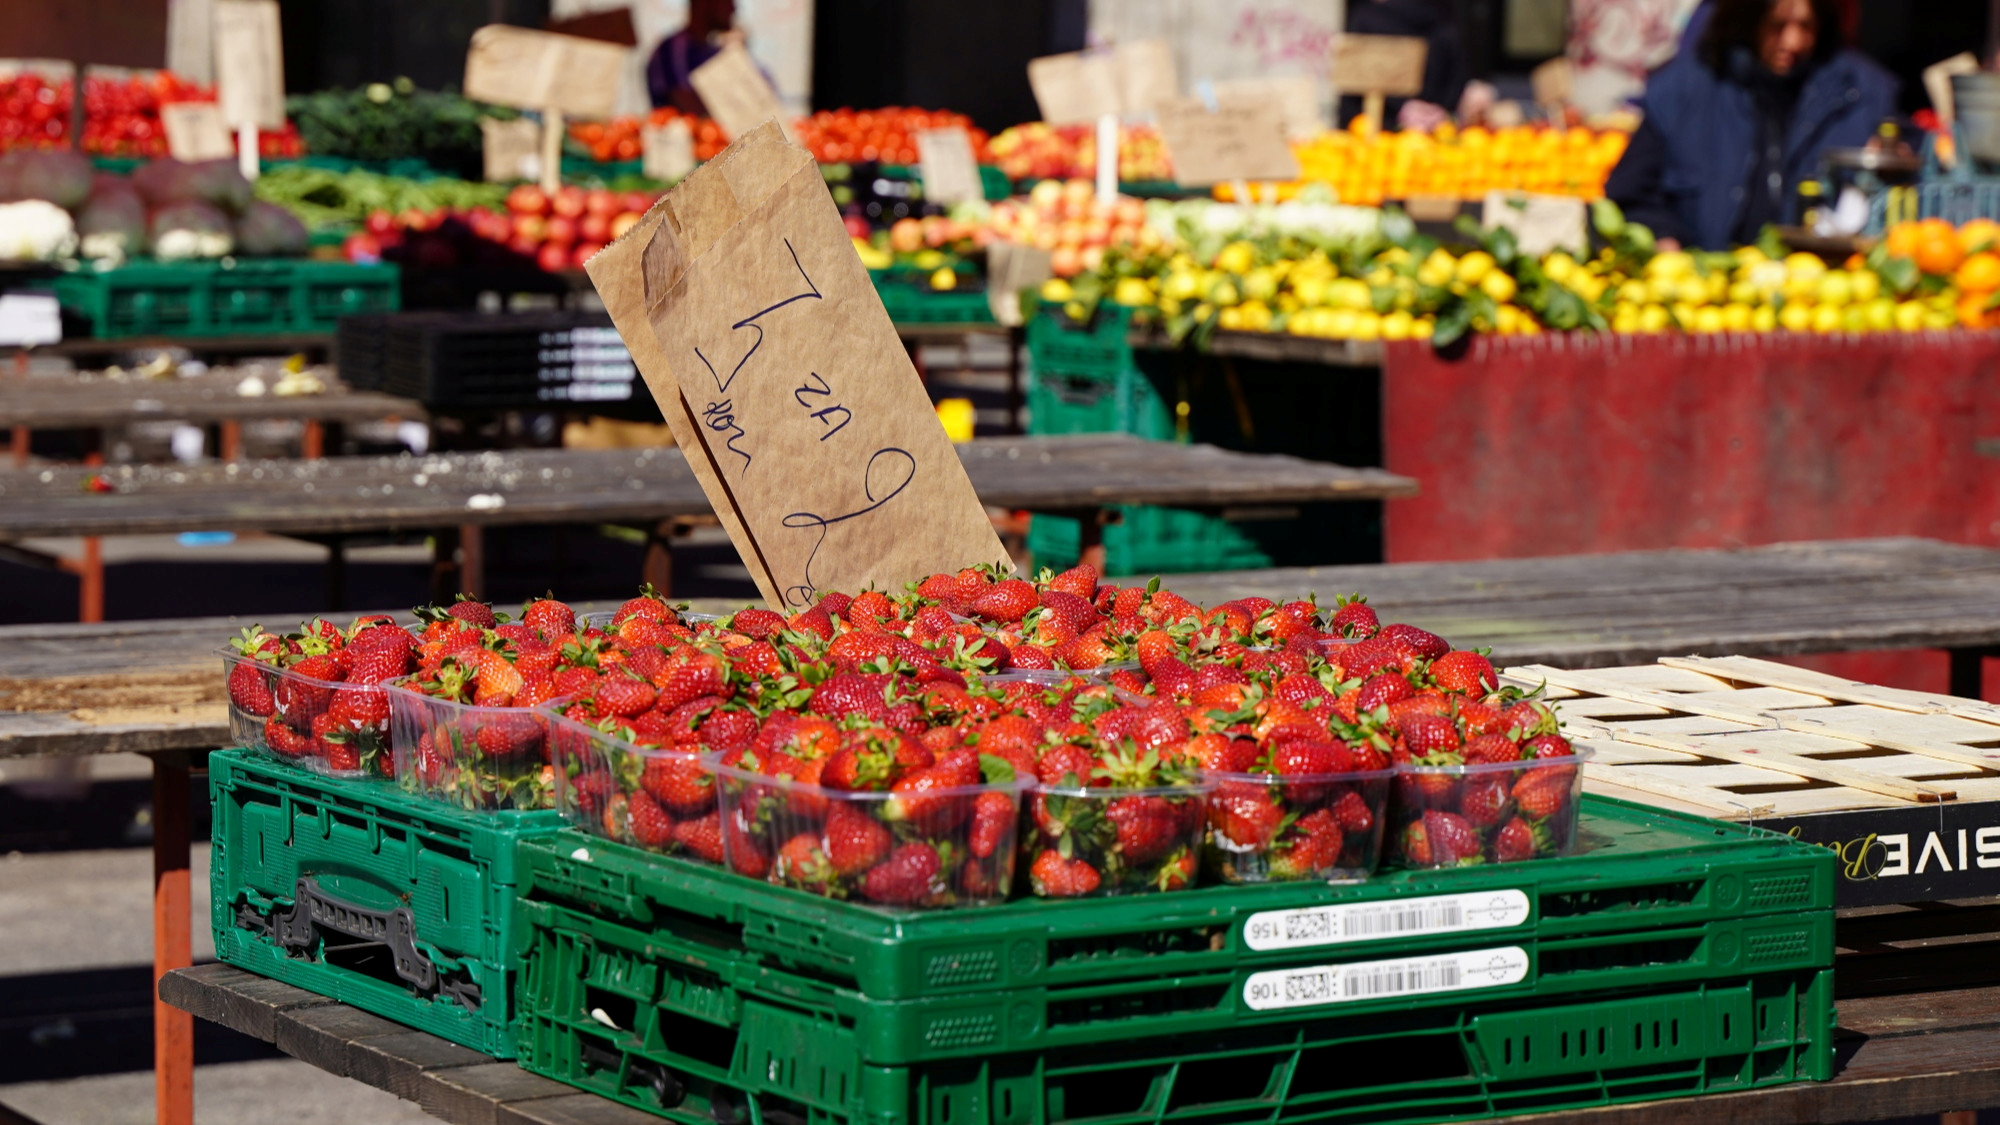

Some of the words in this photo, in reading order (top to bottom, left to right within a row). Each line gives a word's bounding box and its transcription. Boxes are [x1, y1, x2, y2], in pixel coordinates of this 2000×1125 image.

[1876, 825, 2000, 878] SIVE
[1251, 922, 1279, 940] 156
[1251, 982, 1279, 1001] 106
